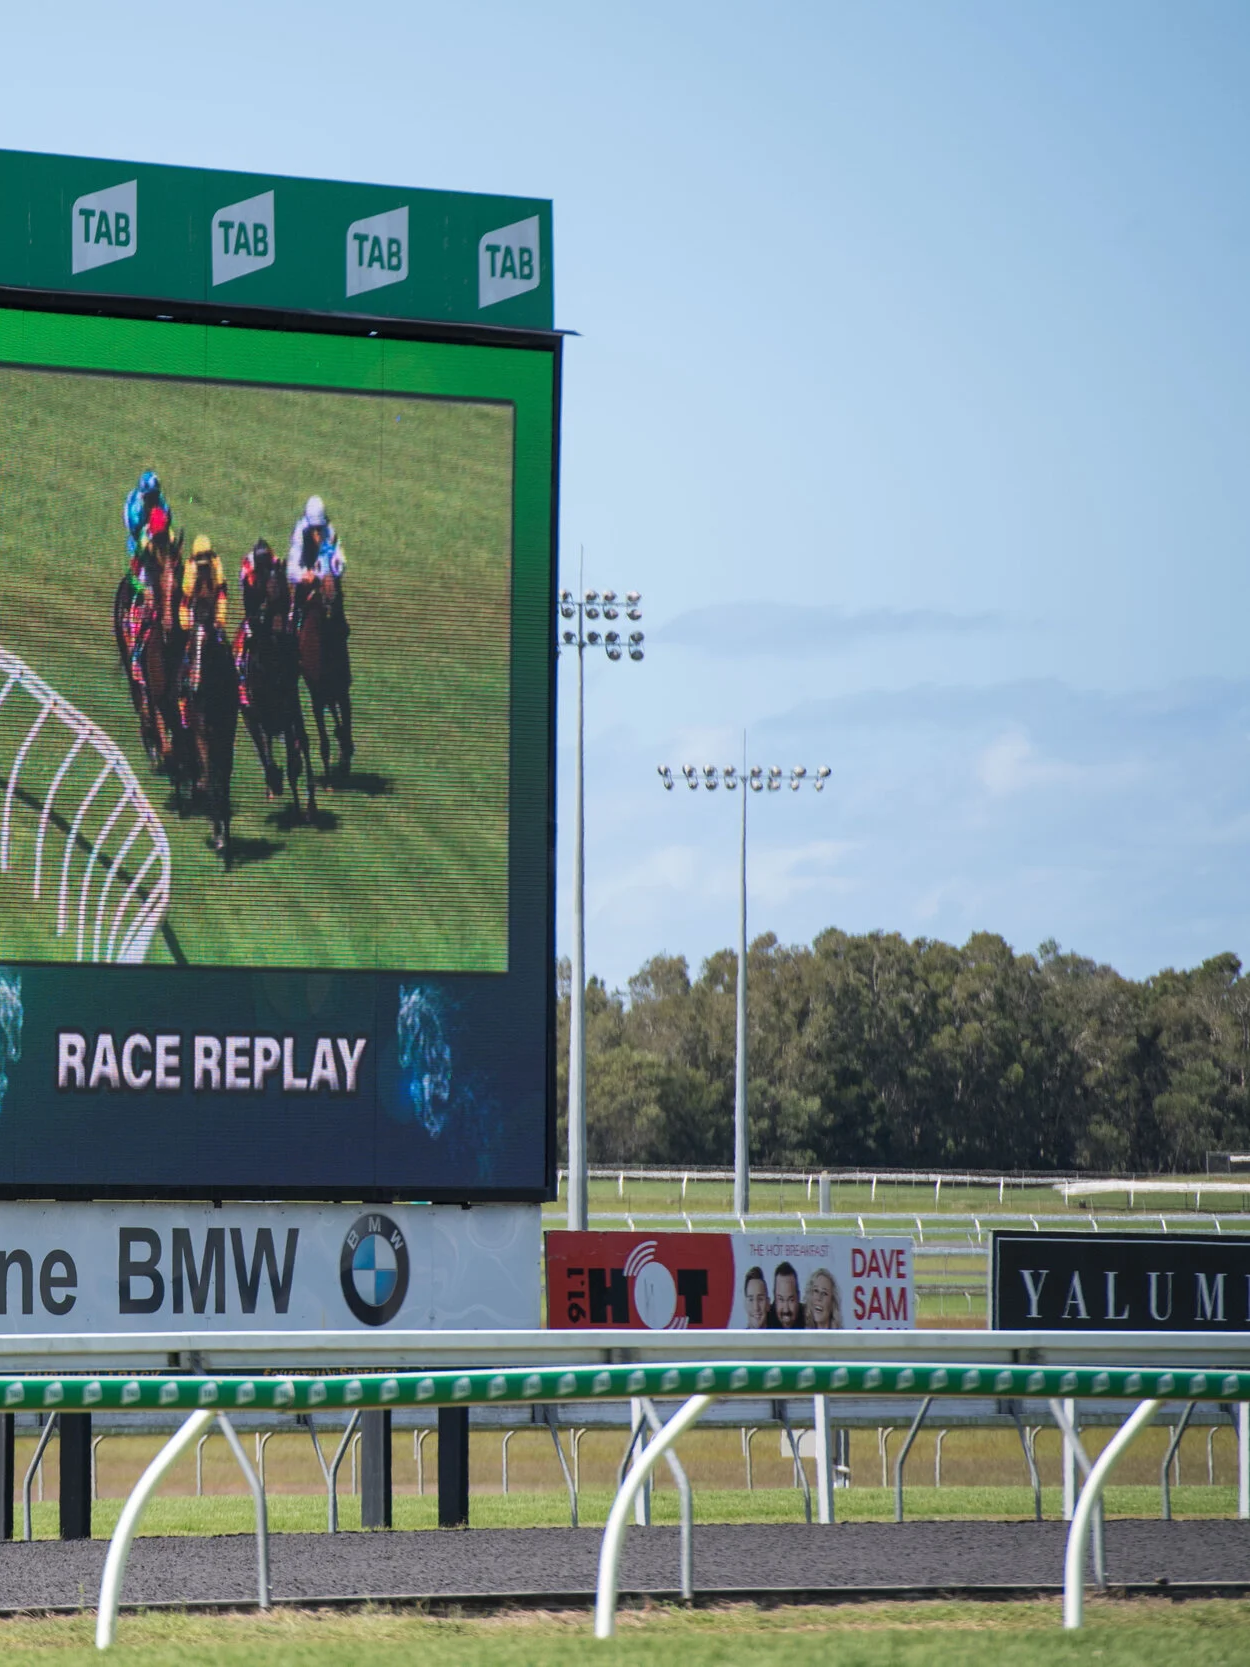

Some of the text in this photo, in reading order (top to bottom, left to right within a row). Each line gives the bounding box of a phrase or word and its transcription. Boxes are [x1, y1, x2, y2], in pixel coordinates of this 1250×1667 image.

[78, 208, 131, 248] TAB
[218, 220, 268, 257] TAB
[353, 233, 402, 272] TAB
[485, 243, 534, 281] TAB
[57, 1032, 367, 1093] RACE REPLAY
[347, 1216, 404, 1250] BMW
[767, 1244, 782, 1257] HOT
[118, 1226, 300, 1314] BMW
[851, 1248, 907, 1279] DAVE
[853, 1285, 908, 1321] SAM
[1019, 1269, 1250, 1322] YALUM
